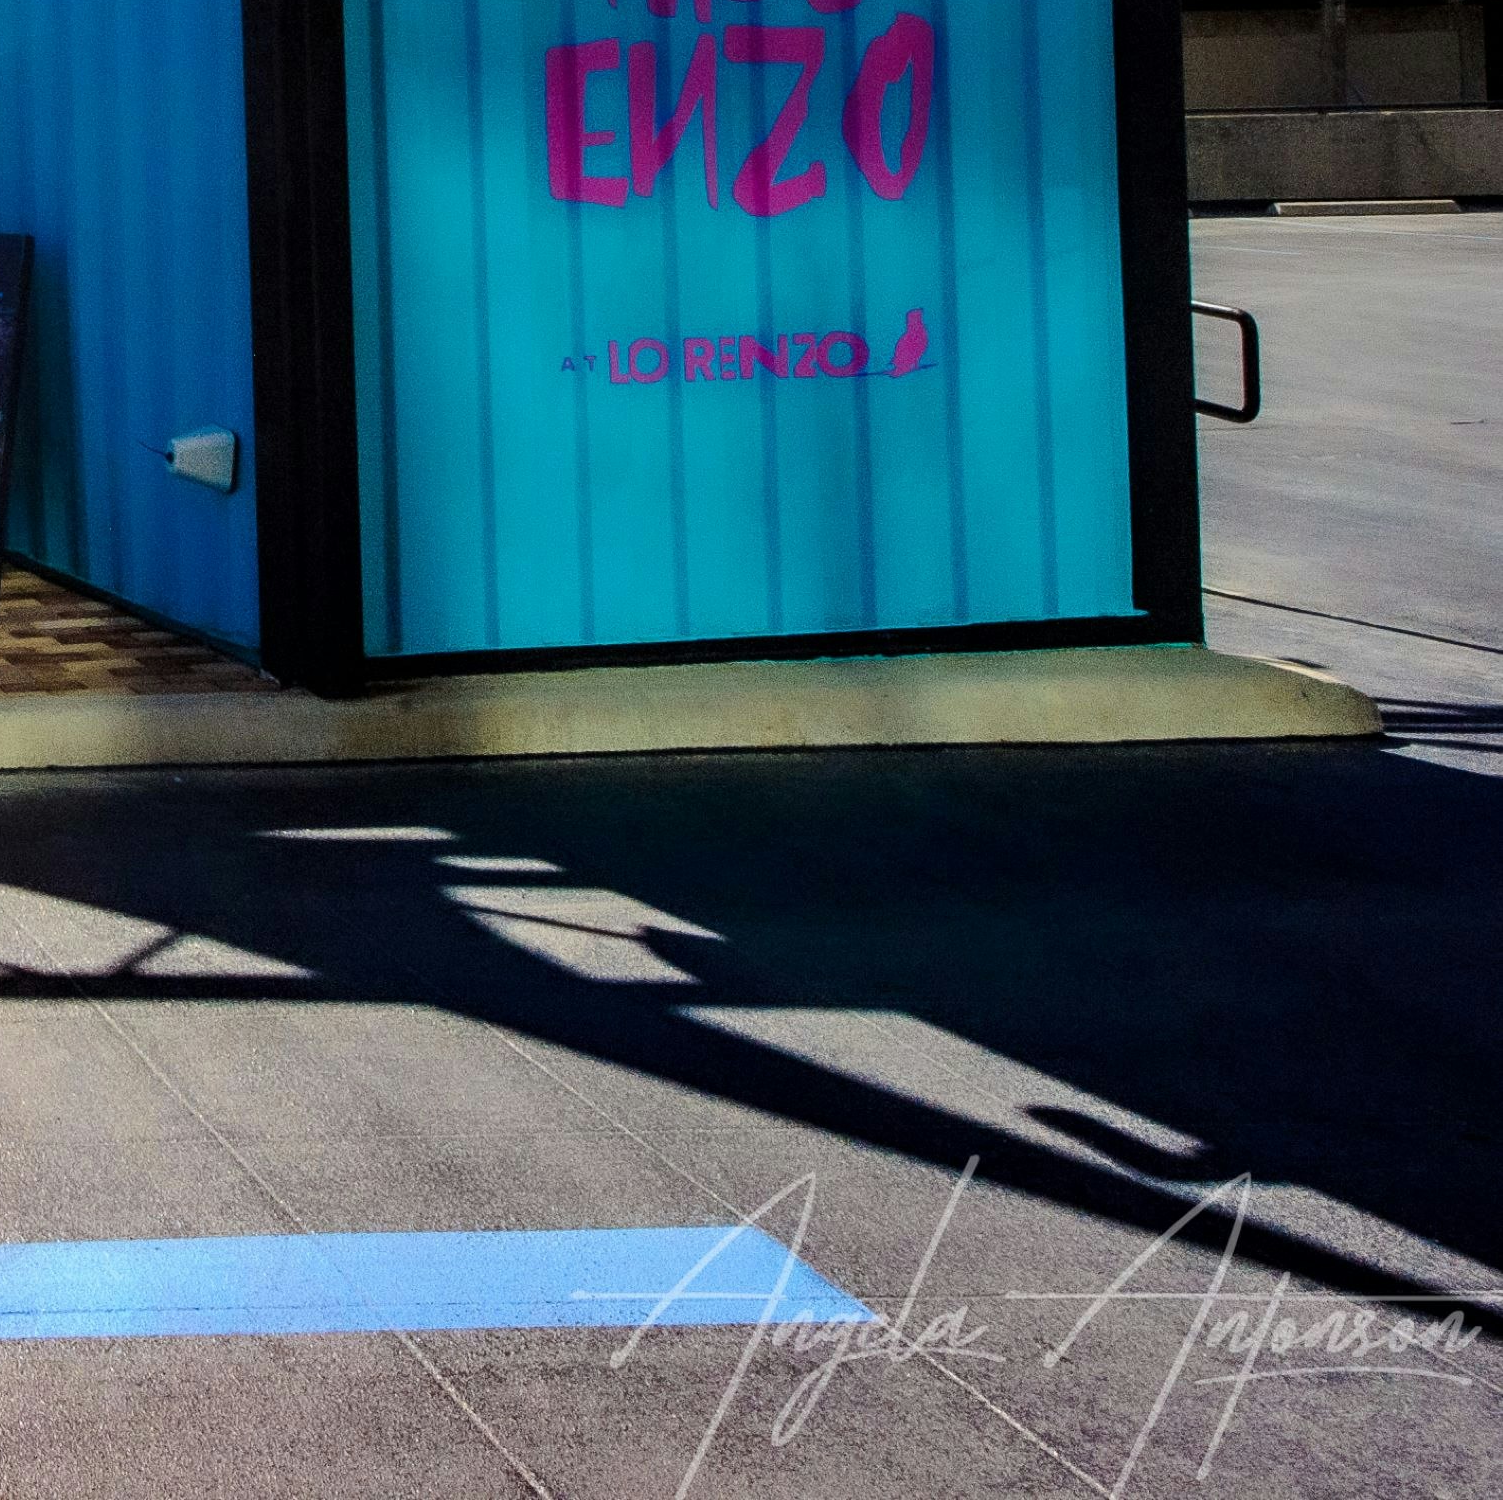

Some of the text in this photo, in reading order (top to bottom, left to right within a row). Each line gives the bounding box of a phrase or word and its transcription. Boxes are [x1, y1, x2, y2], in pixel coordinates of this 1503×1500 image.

[545, 11, 935, 217] ENZO
[561, 331, 871, 384] AT LORENZO
